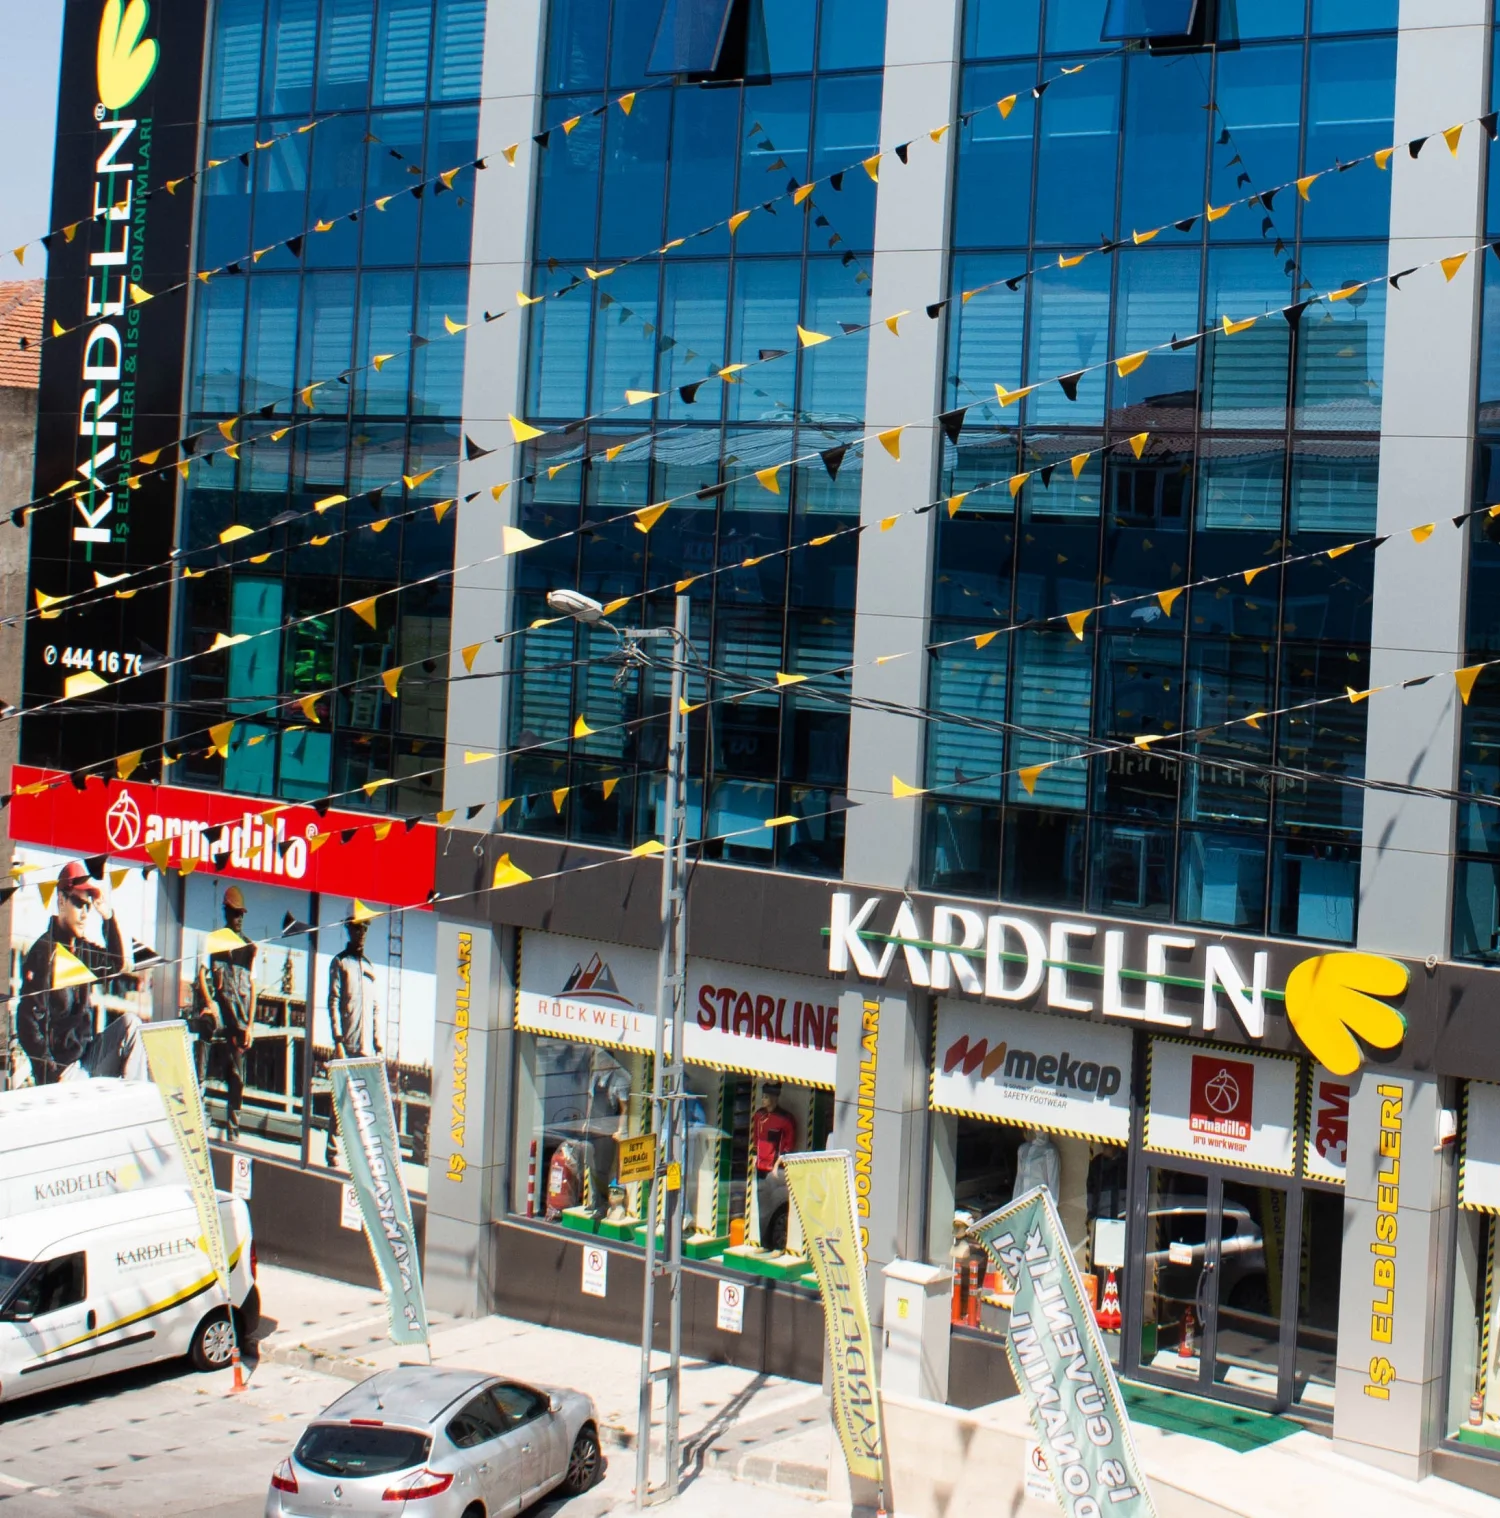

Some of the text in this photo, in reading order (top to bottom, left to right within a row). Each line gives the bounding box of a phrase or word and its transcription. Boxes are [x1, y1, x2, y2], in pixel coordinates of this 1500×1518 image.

[73, 119, 137, 542] KARDELEN
[113, 118, 152, 543] İŞ ELBİSELERİ & İSG ONANIMLARI
[61, 646, 94, 670] 444
[98, 650, 120, 673] 16
[145, 812, 307, 879] armadillo
[829, 892, 1268, 1039] KARDELEN
[538, 998, 642, 1034] ROCKWELL
[697, 984, 840, 1053] STARLINE
[446, 931, 473, 1184] İŞ AYAKKABILARI
[1004, 1050, 1121, 1101] mekap
[856, 1001, 880, 1219] DONANIMLARI
[1003, 1090, 1029, 1103] SAFETY
[1029, 1095, 1068, 1109] FOOTWEAR
[1191, 1117, 1247, 1138] armadillo
[1316, 1081, 1350, 1163] 3M
[1193, 1135, 1248, 1152] pro workwear
[35, 1169, 118, 1201] KARDELEN
[115, 1237, 197, 1267] KARDELEN
[1364, 1084, 1404, 1401] İŞ ELBİSELERİ
